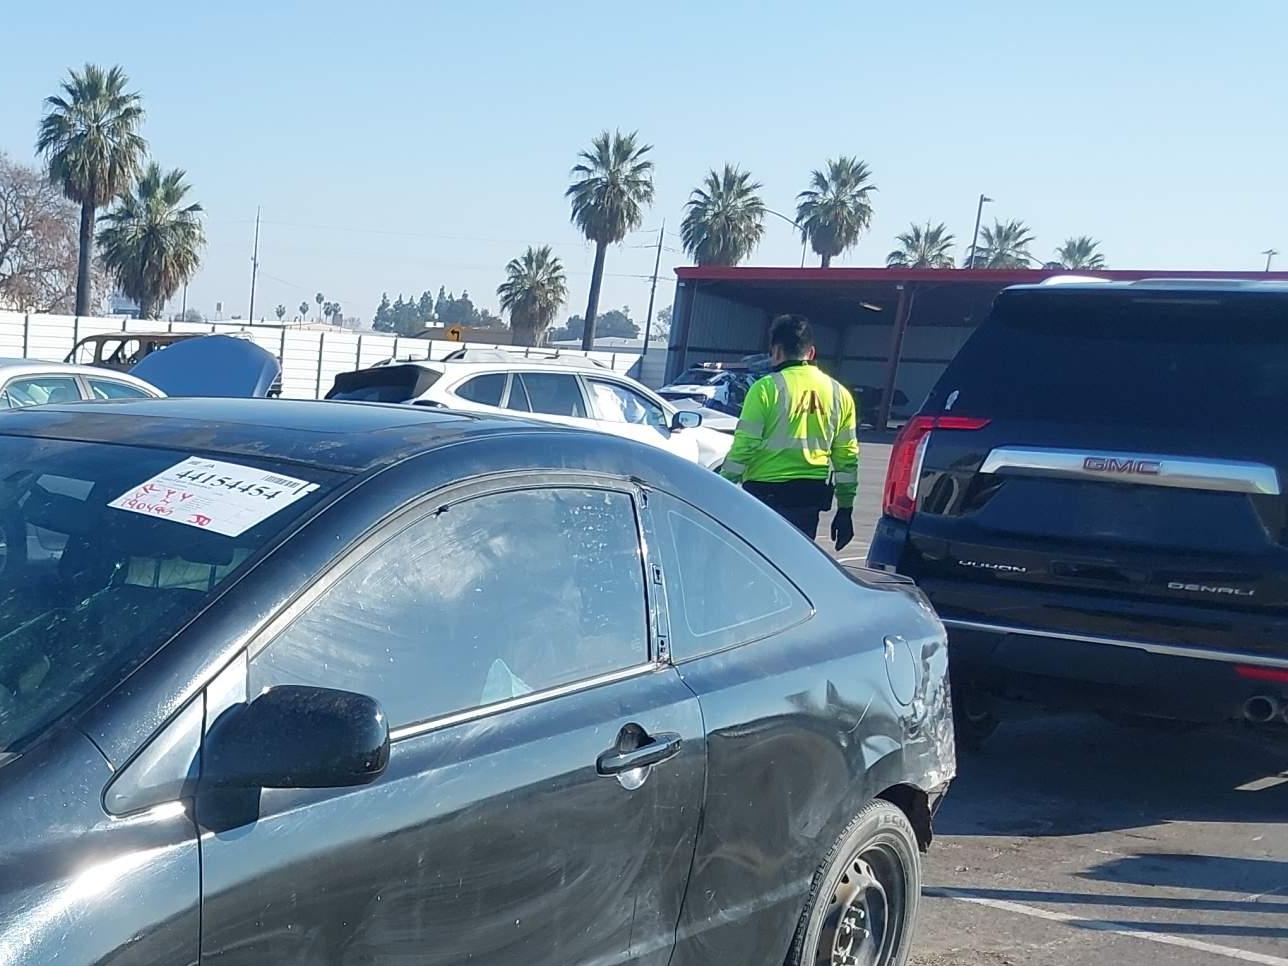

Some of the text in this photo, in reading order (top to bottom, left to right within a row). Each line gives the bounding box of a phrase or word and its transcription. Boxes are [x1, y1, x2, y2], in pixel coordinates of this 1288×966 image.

[1083, 456, 1161, 474] GMC
[175, 470, 283, 500] 44154454
[1167, 582, 1255, 596] DENALI
